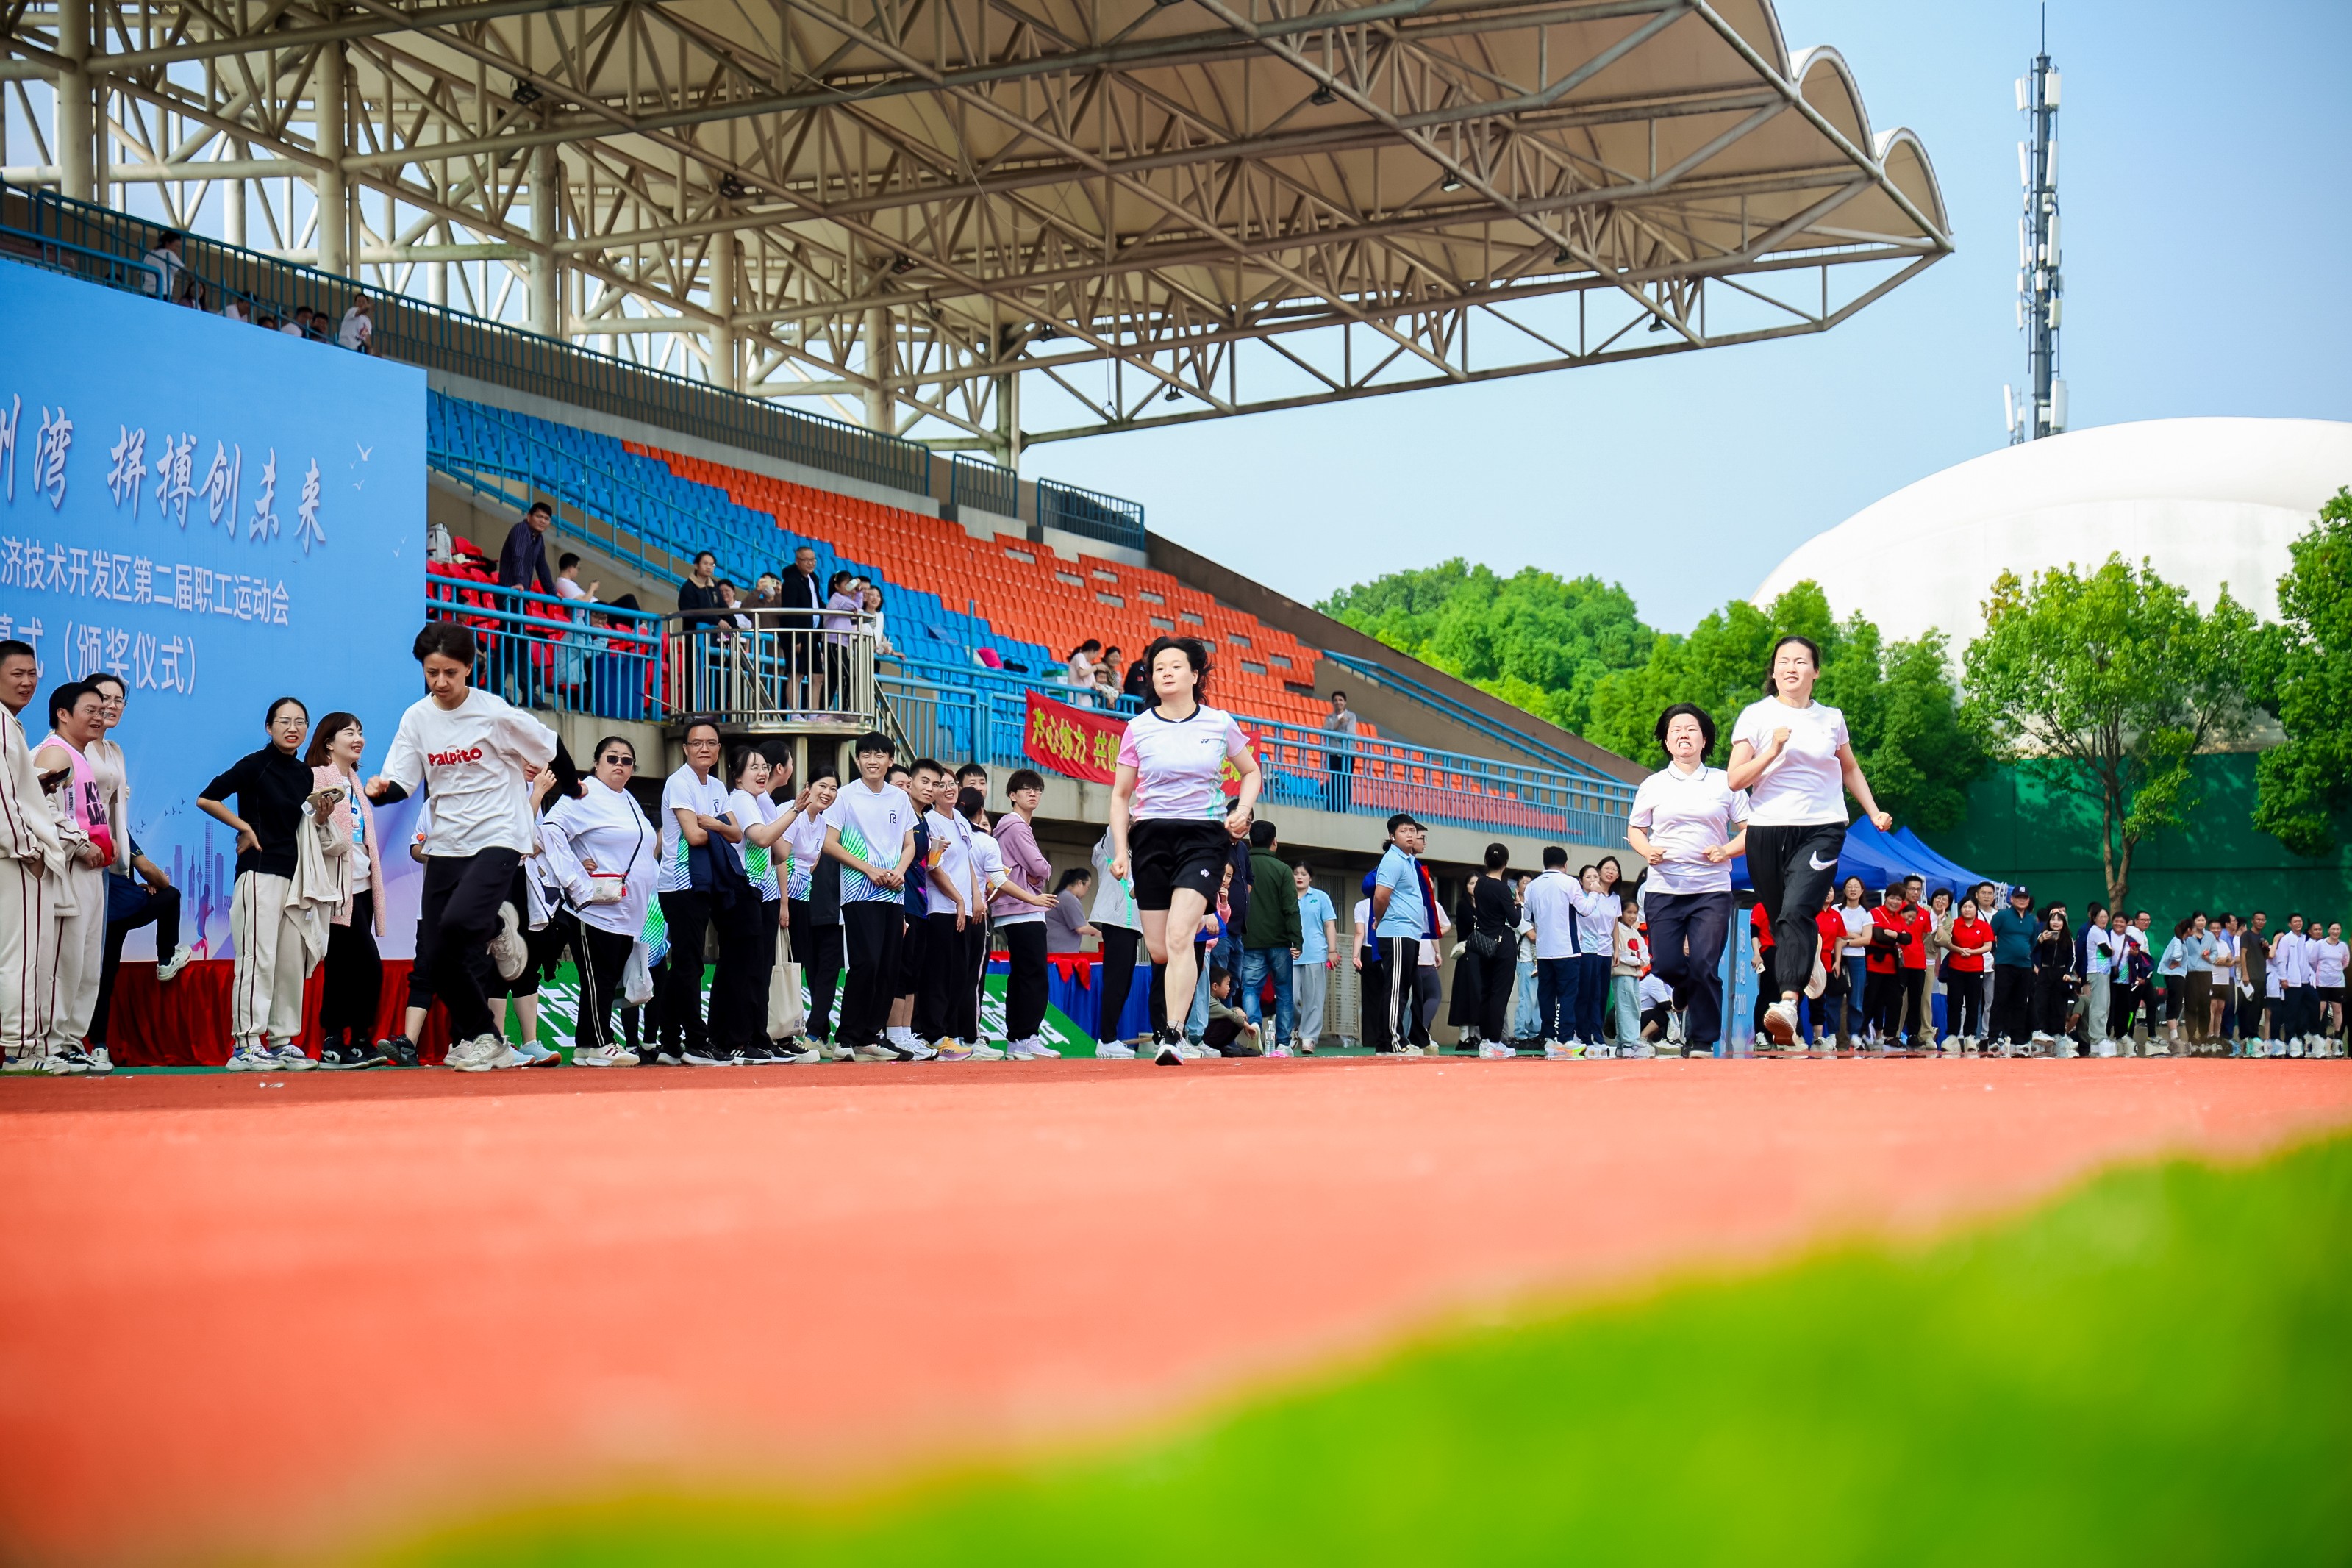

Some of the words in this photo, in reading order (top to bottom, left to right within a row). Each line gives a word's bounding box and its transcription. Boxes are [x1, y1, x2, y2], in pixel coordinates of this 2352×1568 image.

[107, 423, 326, 554] 拼搏创未来
[1, 536, 290, 626] 济技术开发区第二届职工运动会
